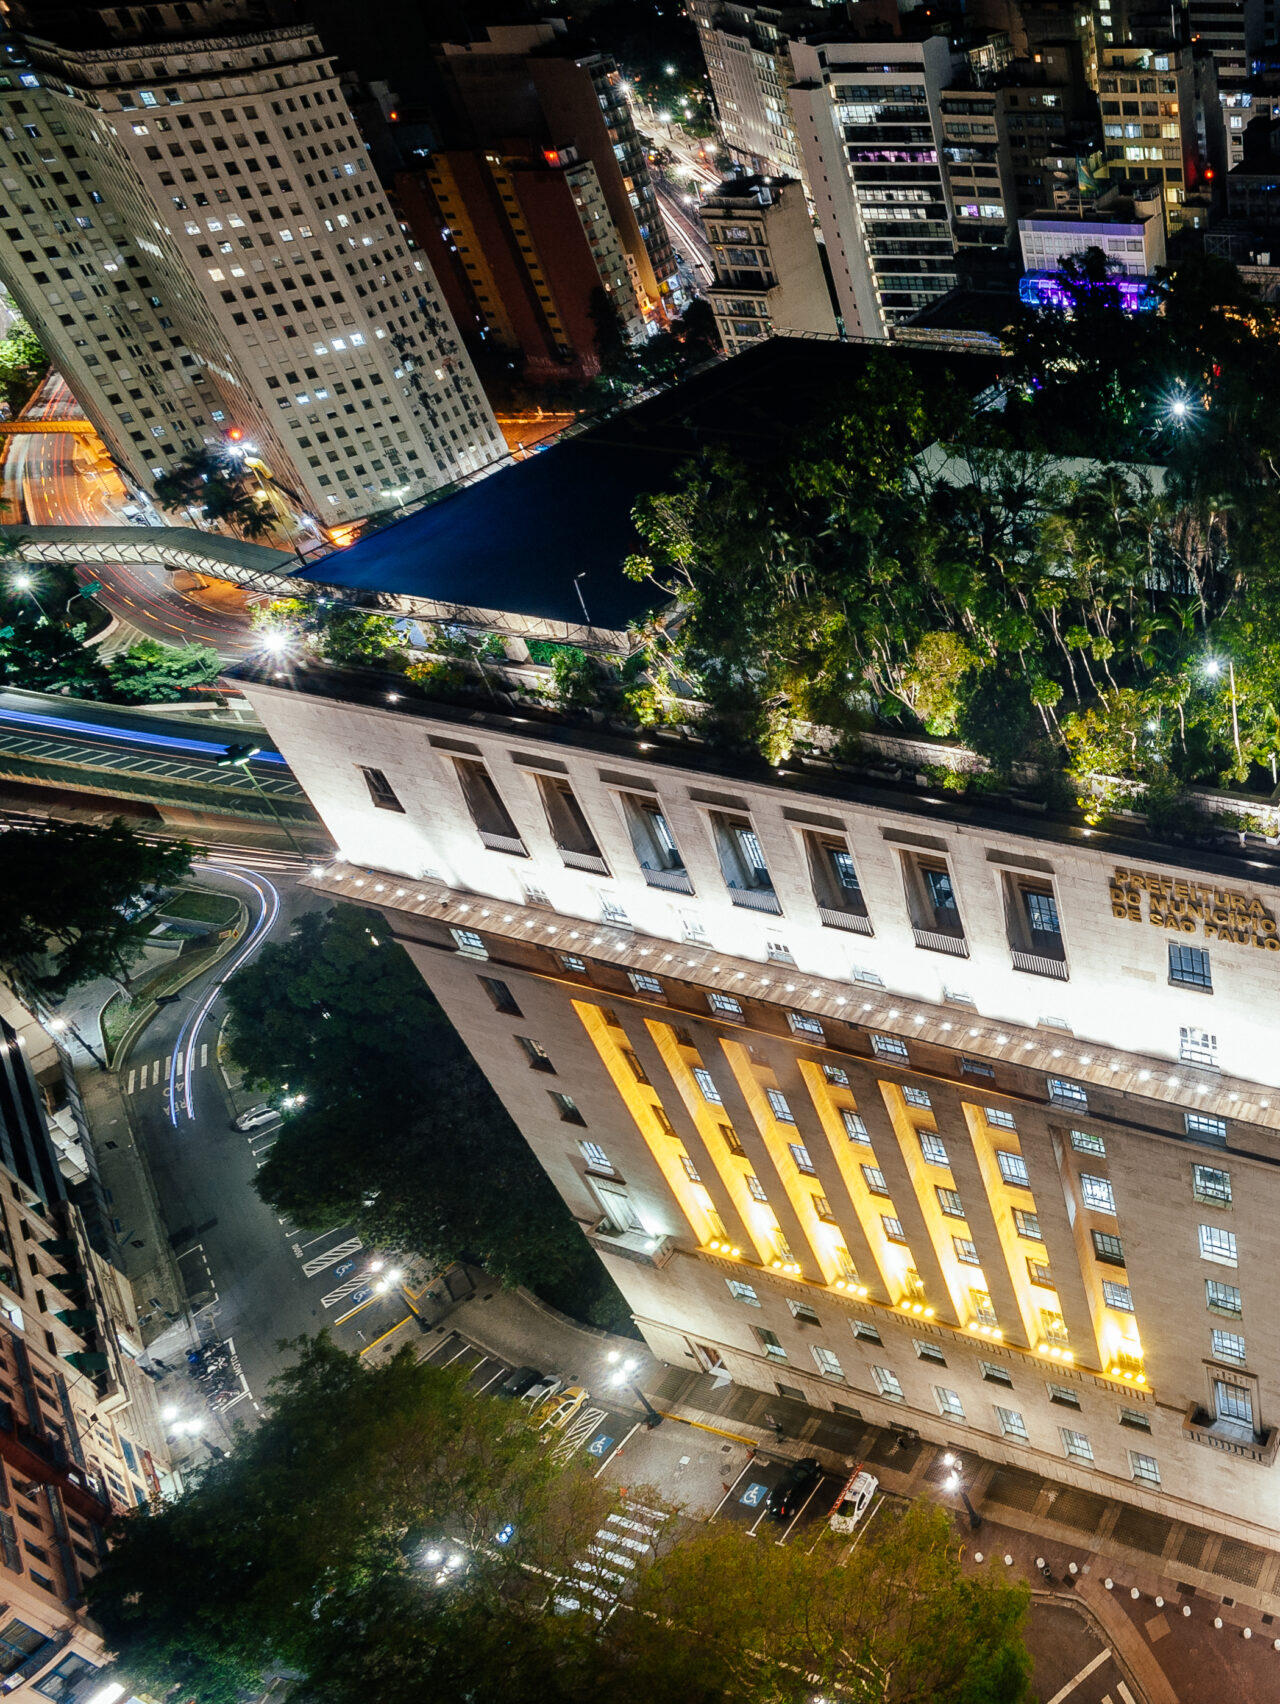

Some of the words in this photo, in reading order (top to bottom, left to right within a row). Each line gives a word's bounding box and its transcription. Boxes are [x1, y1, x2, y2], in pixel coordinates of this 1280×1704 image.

[1110, 887, 1142, 906] DO
[1150, 896, 1277, 933] MUNICÍPIO
[1114, 871, 1267, 916] PREFEITURA
[1112, 904, 1142, 923] DE
[1150, 913, 1196, 934] SÃO
[1204, 924, 1280, 952] PAULO
